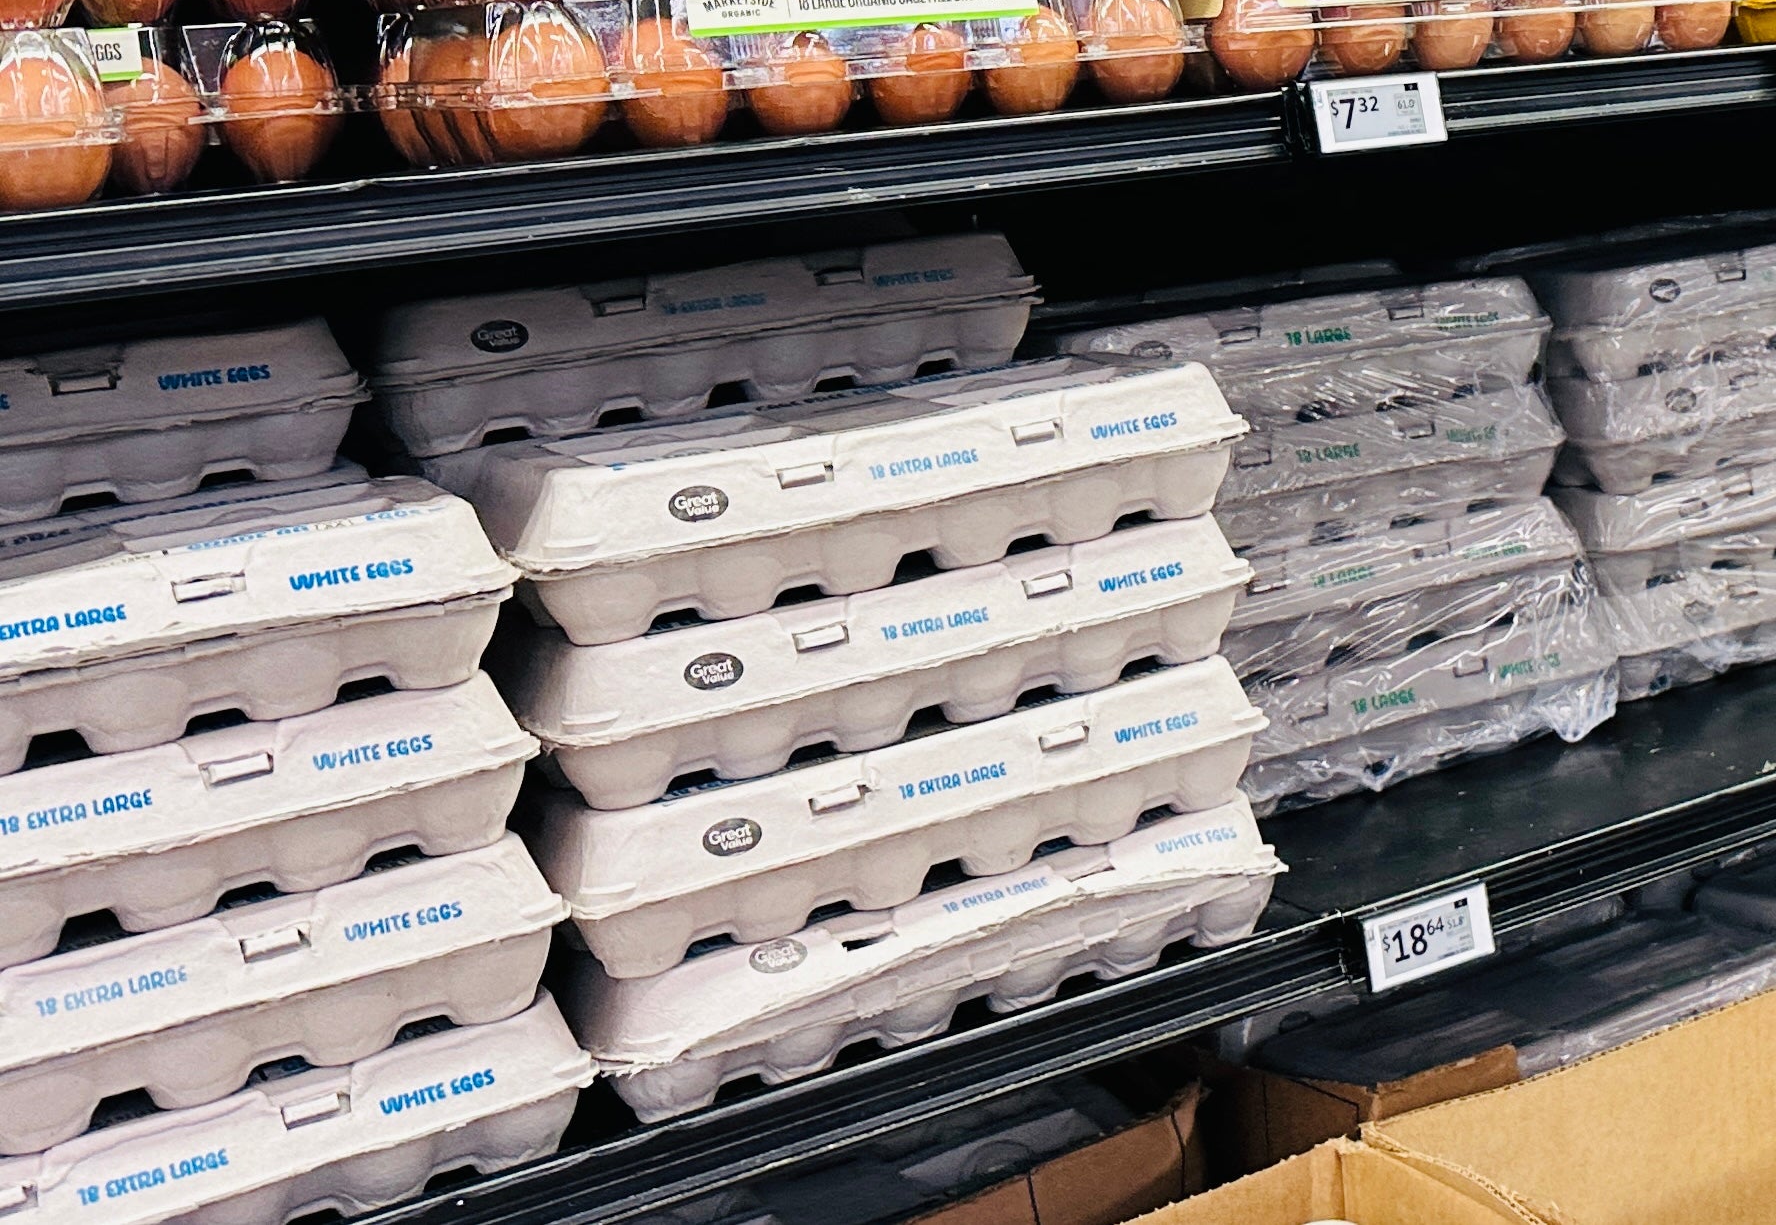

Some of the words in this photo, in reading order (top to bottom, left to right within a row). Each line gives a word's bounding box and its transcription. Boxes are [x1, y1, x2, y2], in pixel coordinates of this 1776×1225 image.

[1285, 330, 1302, 346] 18
[1306, 325, 1352, 345] LARGE
[1089, 418, 1139, 441] WHITE
[1142, 412, 1177, 431] EGGS
[868, 462, 886, 481] 18
[889, 455, 933, 477] EXTRA
[935, 447, 979, 468] LARGE
[673, 490, 719, 511] Great
[685, 502, 720, 518] Value
[289, 567, 361, 592] WHITE
[366, 558, 414, 579] EGGS
[1098, 570, 1148, 594] WHITE
[1149, 561, 1184, 582] EGGS
[880, 623, 899, 641] 18
[901, 617, 944, 638] EXTRA
[947, 607, 989, 629] LARGE
[689, 658, 734, 679] Great
[702, 668, 736, 686] Value
[1350, 699, 1367, 714] 18
[1370, 688, 1416, 710] LARGE
[1113, 719, 1164, 745] WHITE
[1164, 710, 1198, 733] EGGS
[312, 743, 382, 772] WHITE
[385, 734, 433, 758] EGGS
[899, 782, 916, 800] 18
[918, 775, 962, 796] EXTRA
[963, 762, 1007, 785] LARGE
[708, 823, 751, 846] Great
[343, 913, 412, 942] WHITE
[416, 901, 463, 927] EGGS
[36, 997, 58, 1018] 18
[63, 982, 124, 1012] EXTRA
[128, 965, 187, 995] LARGE
[379, 1081, 445, 1116] WHITE
[450, 1069, 495, 1095] EGGS
[77, 1185, 100, 1207] 18
[105, 1167, 166, 1200] EXTRA
[168, 1148, 229, 1179] LARGE
